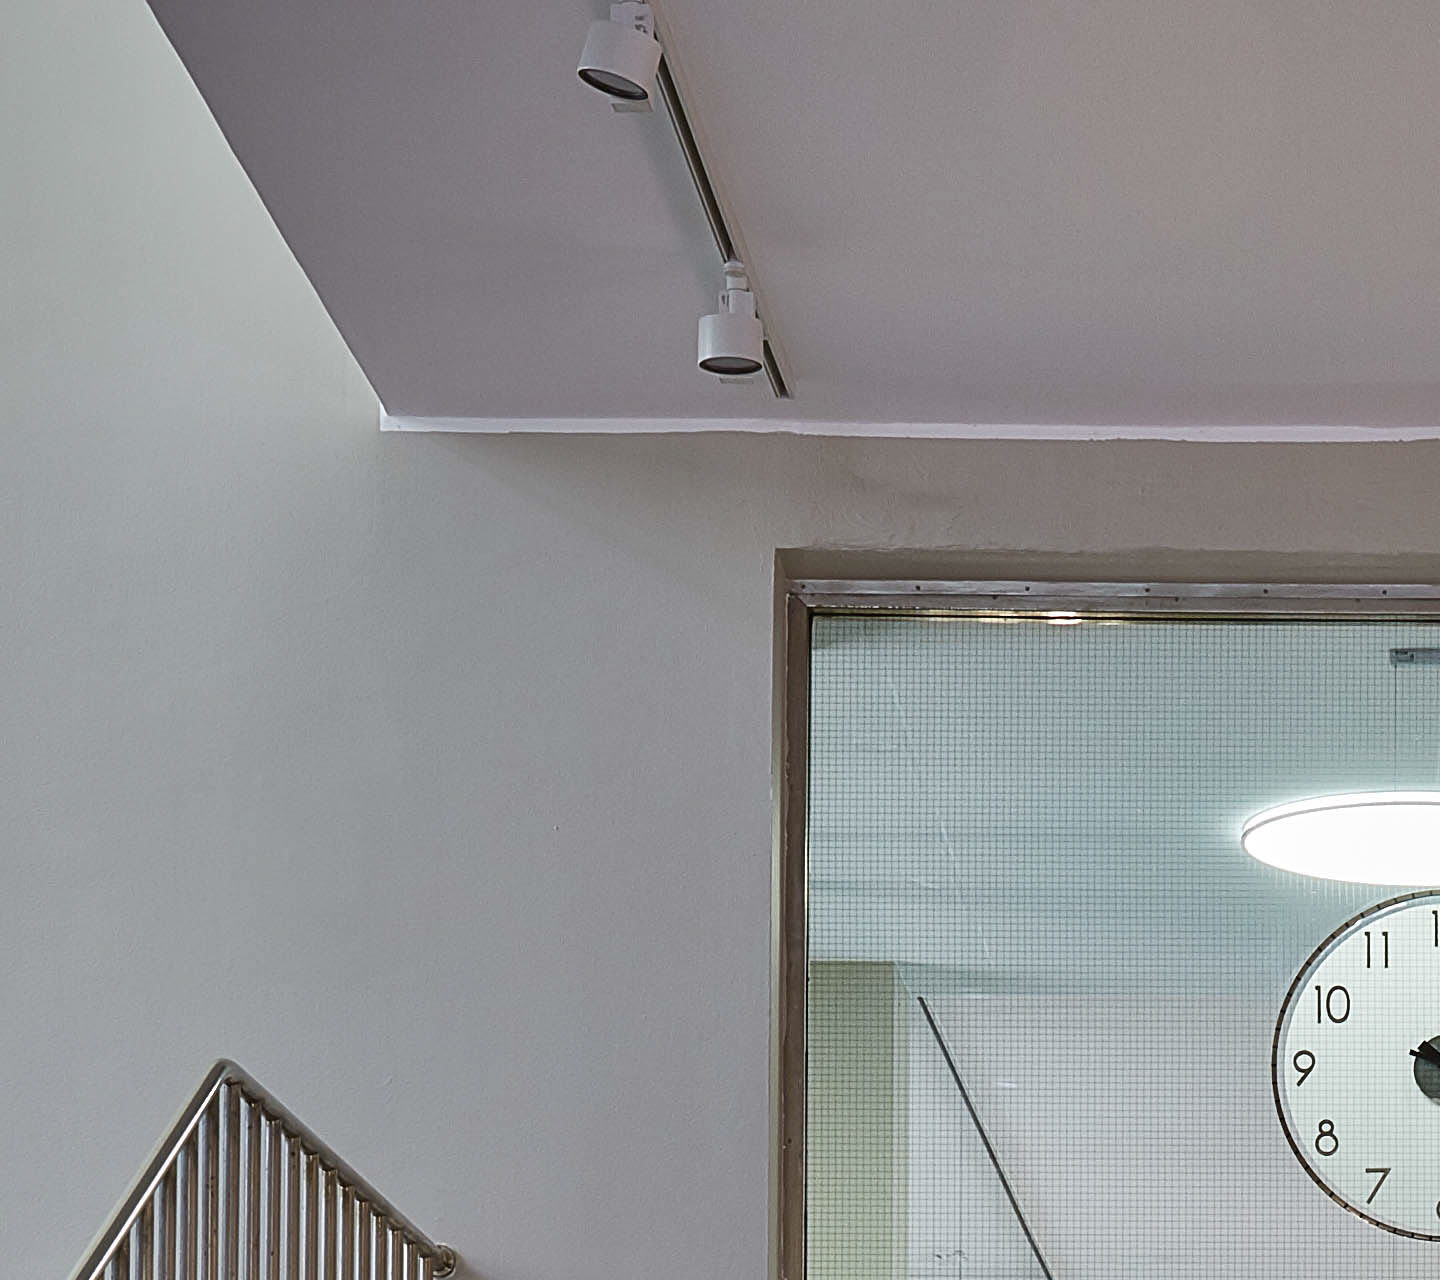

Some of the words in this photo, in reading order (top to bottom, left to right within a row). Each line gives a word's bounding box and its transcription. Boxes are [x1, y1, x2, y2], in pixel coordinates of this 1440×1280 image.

[1365, 931, 1389, 968] 11
[1314, 985, 1350, 1023] 10
[1293, 1050, 1315, 1086] 9
[1315, 1120, 1339, 1156] 8
[1365, 1168, 1391, 1204] 7
